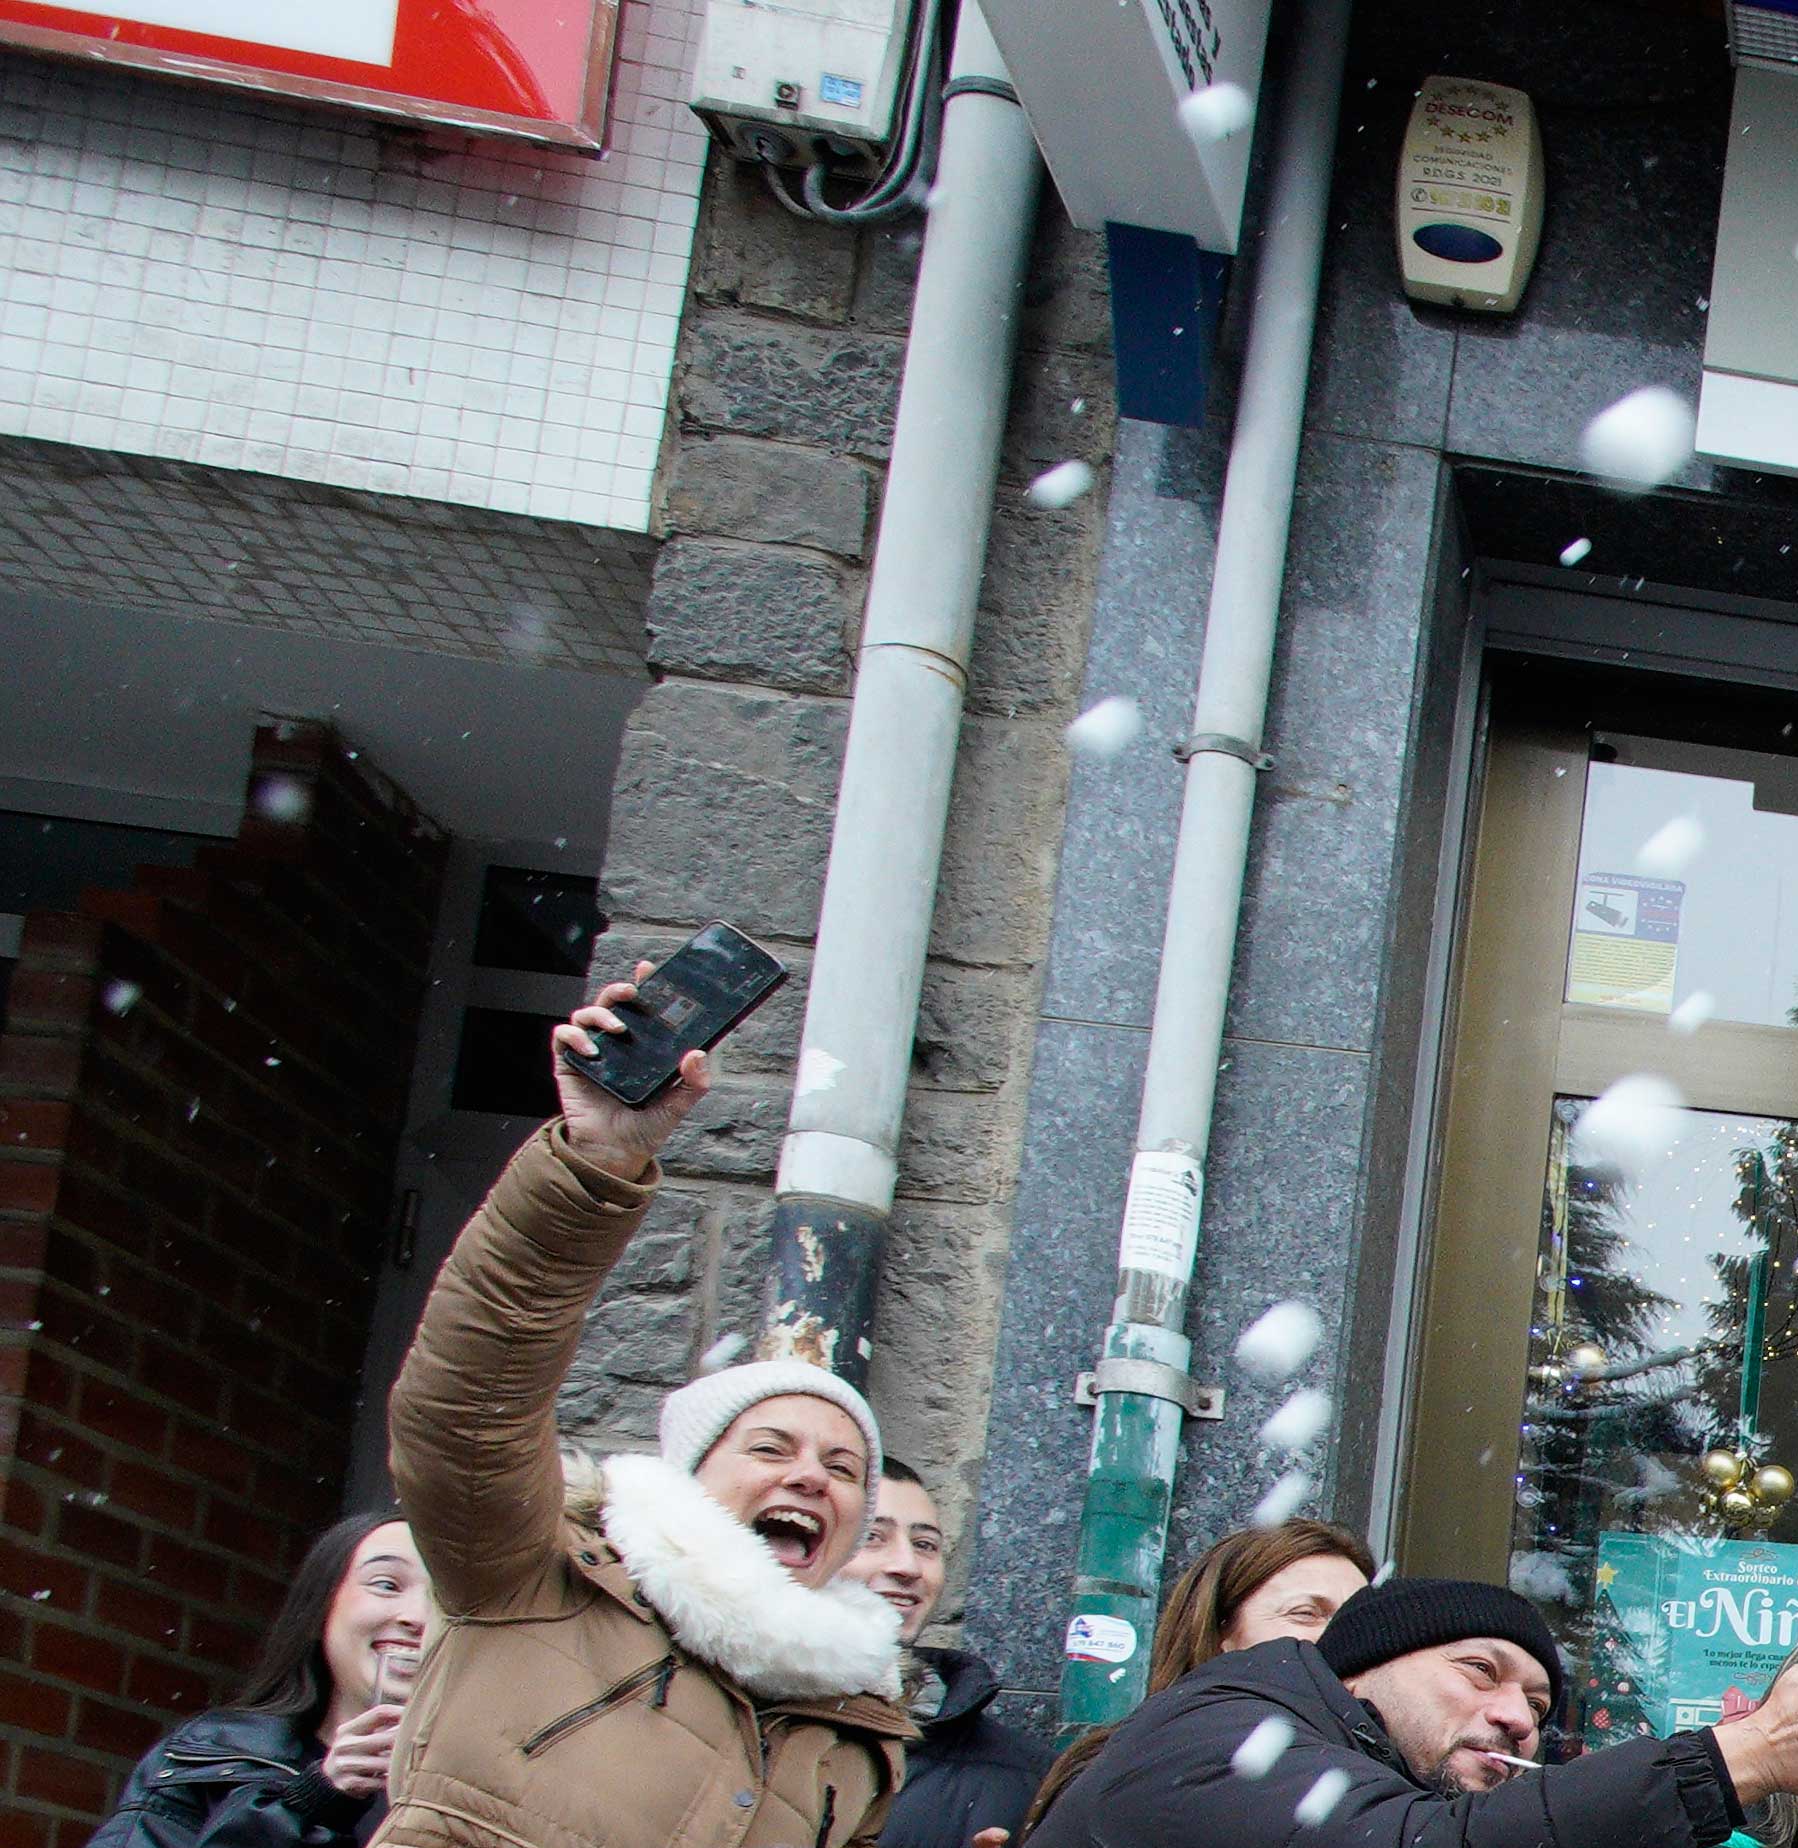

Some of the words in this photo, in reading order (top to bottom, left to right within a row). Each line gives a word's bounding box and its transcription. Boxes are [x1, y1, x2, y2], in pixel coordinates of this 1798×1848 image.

[1423, 102, 1514, 126] DESECOM
[1737, 1560, 1779, 1574] Sorteo
[1703, 1569, 1794, 1586] Extraordinario
[1661, 1599, 1697, 1629] El
[1717, 1650, 1743, 1659] mejor
[1767, 1653, 1786, 1661] cua
[1760, 1663, 1781, 1671] espe
